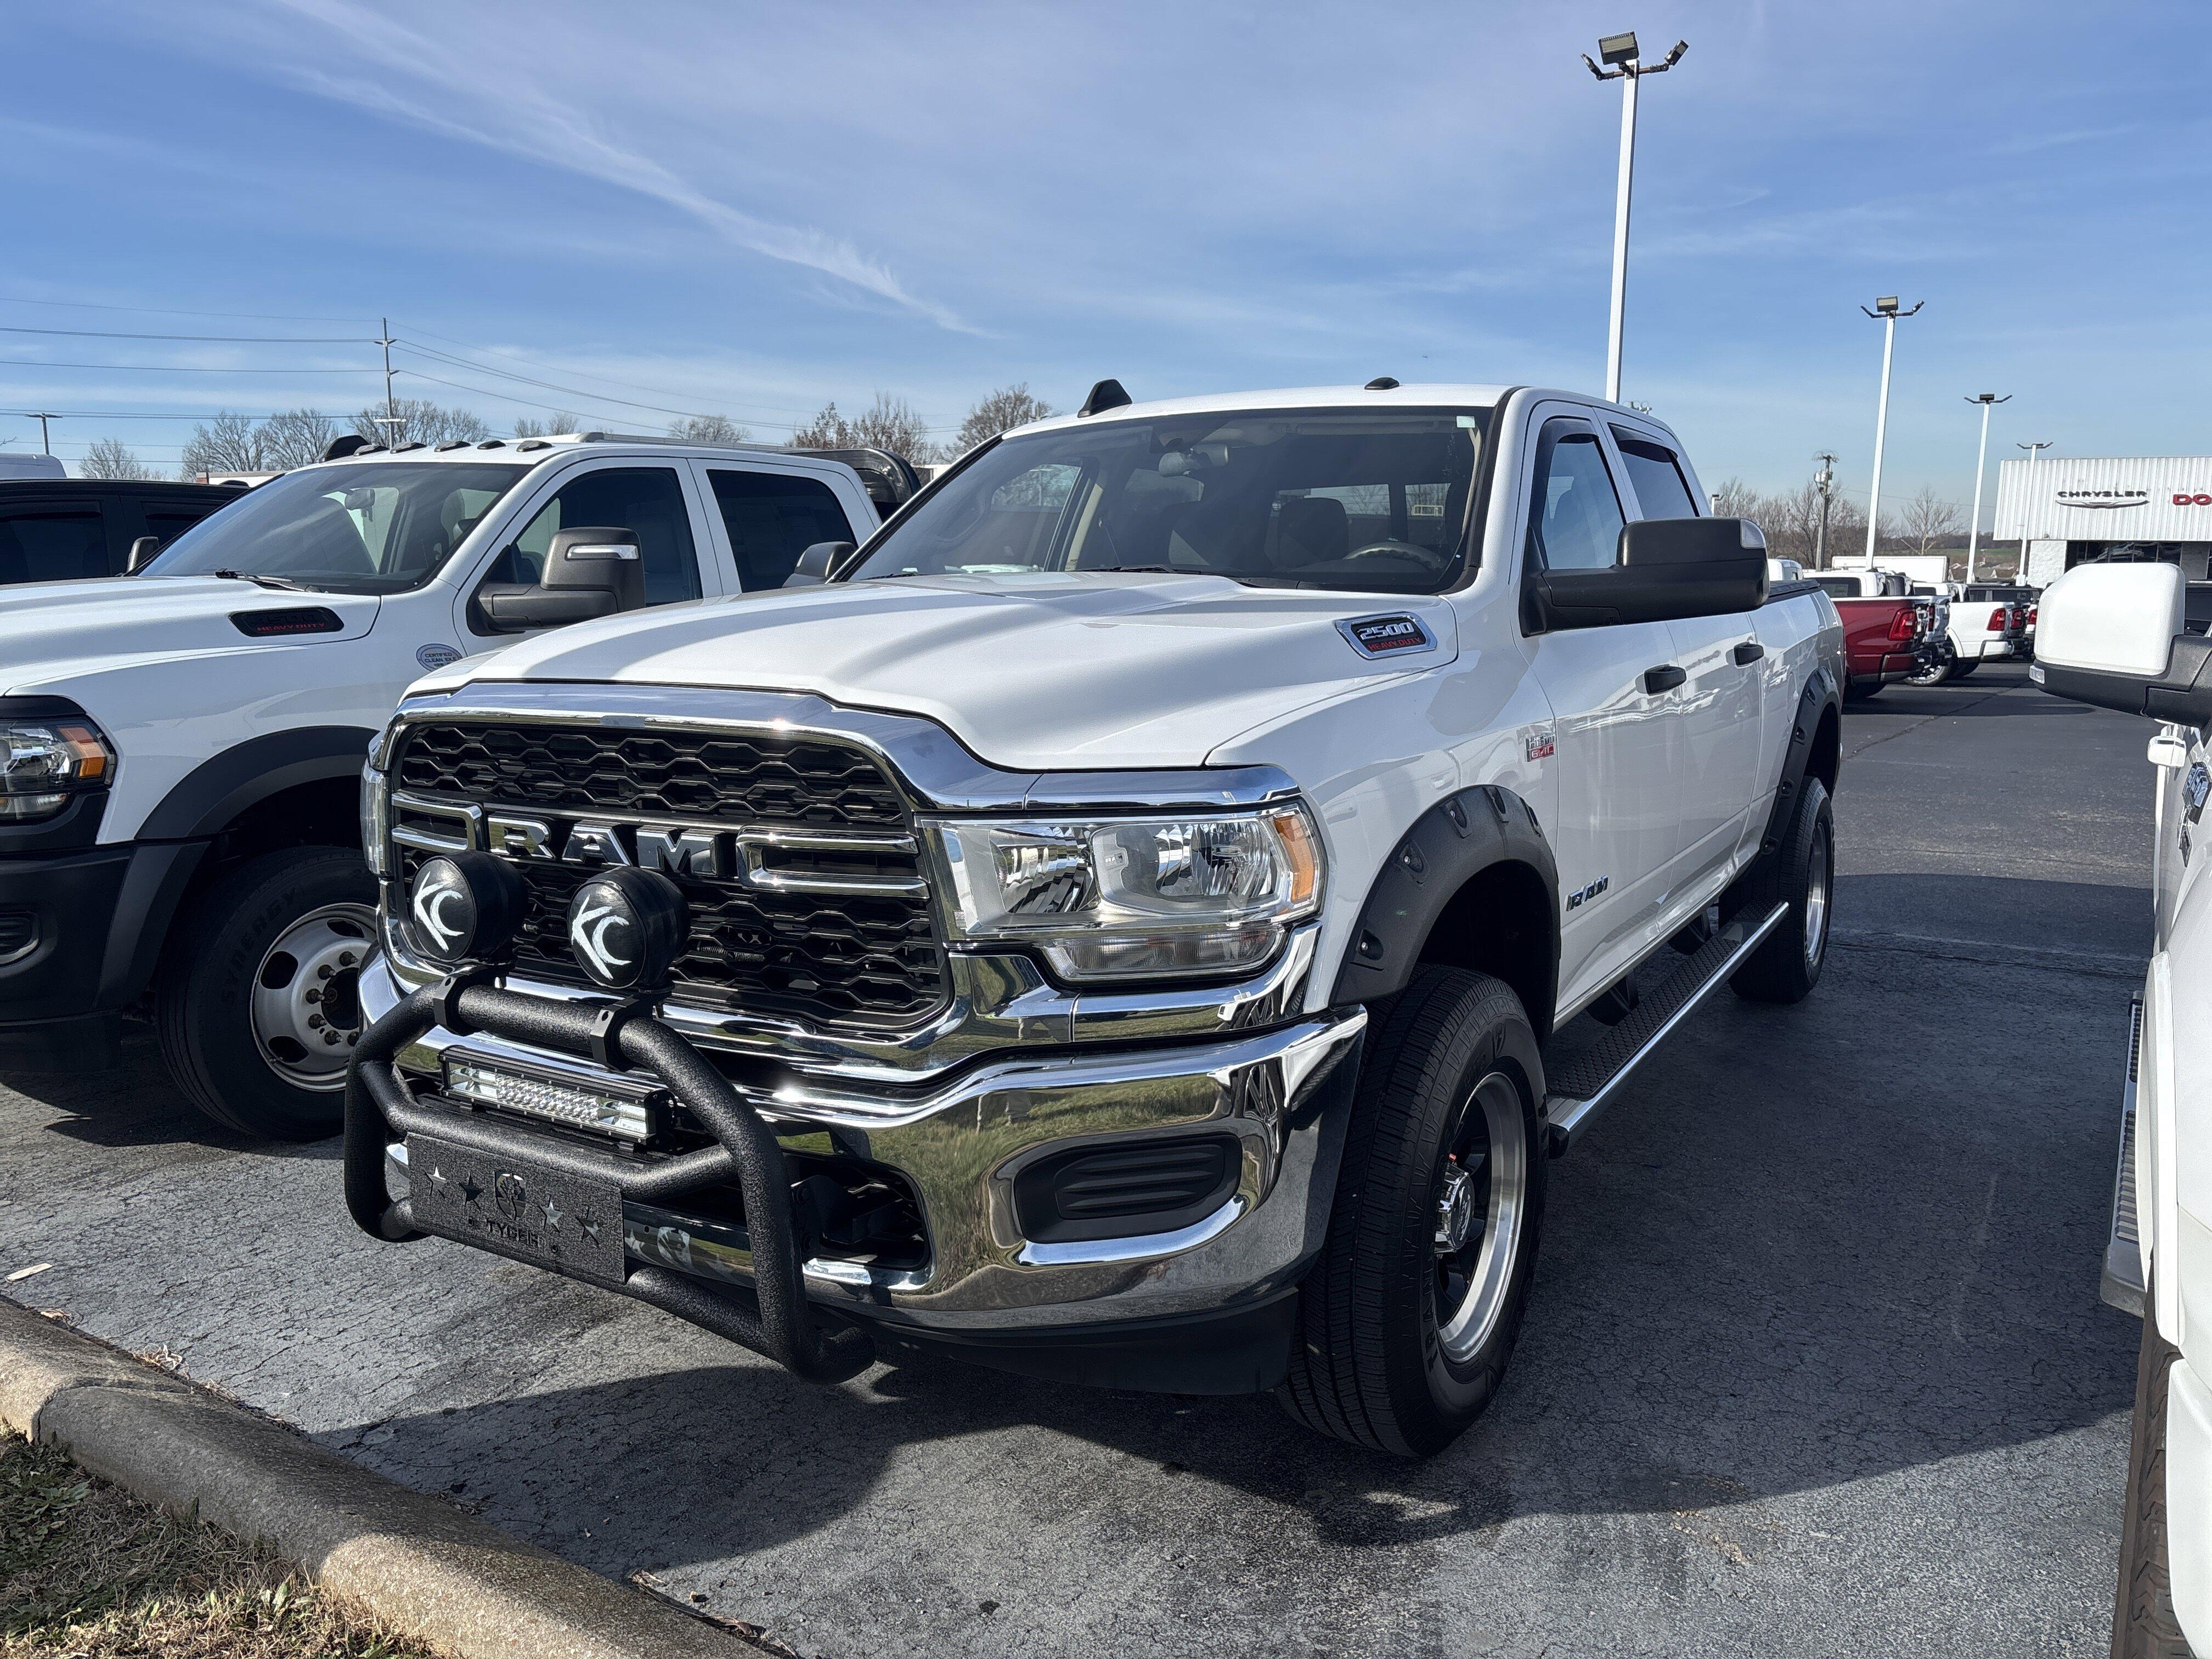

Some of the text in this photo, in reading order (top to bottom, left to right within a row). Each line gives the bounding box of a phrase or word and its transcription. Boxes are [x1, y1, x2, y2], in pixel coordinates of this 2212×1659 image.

[1357, 622, 1414, 640] 2500
[1367, 637, 1421, 650] HEAVY DUTY
[1526, 735, 1555, 748] HEMI
[487, 815, 720, 877] RAM
[1566, 874, 1609, 911] RAM
[414, 871, 465, 953] KC
[571, 894, 631, 980] KC
[487, 1221, 539, 1246] TYGER
